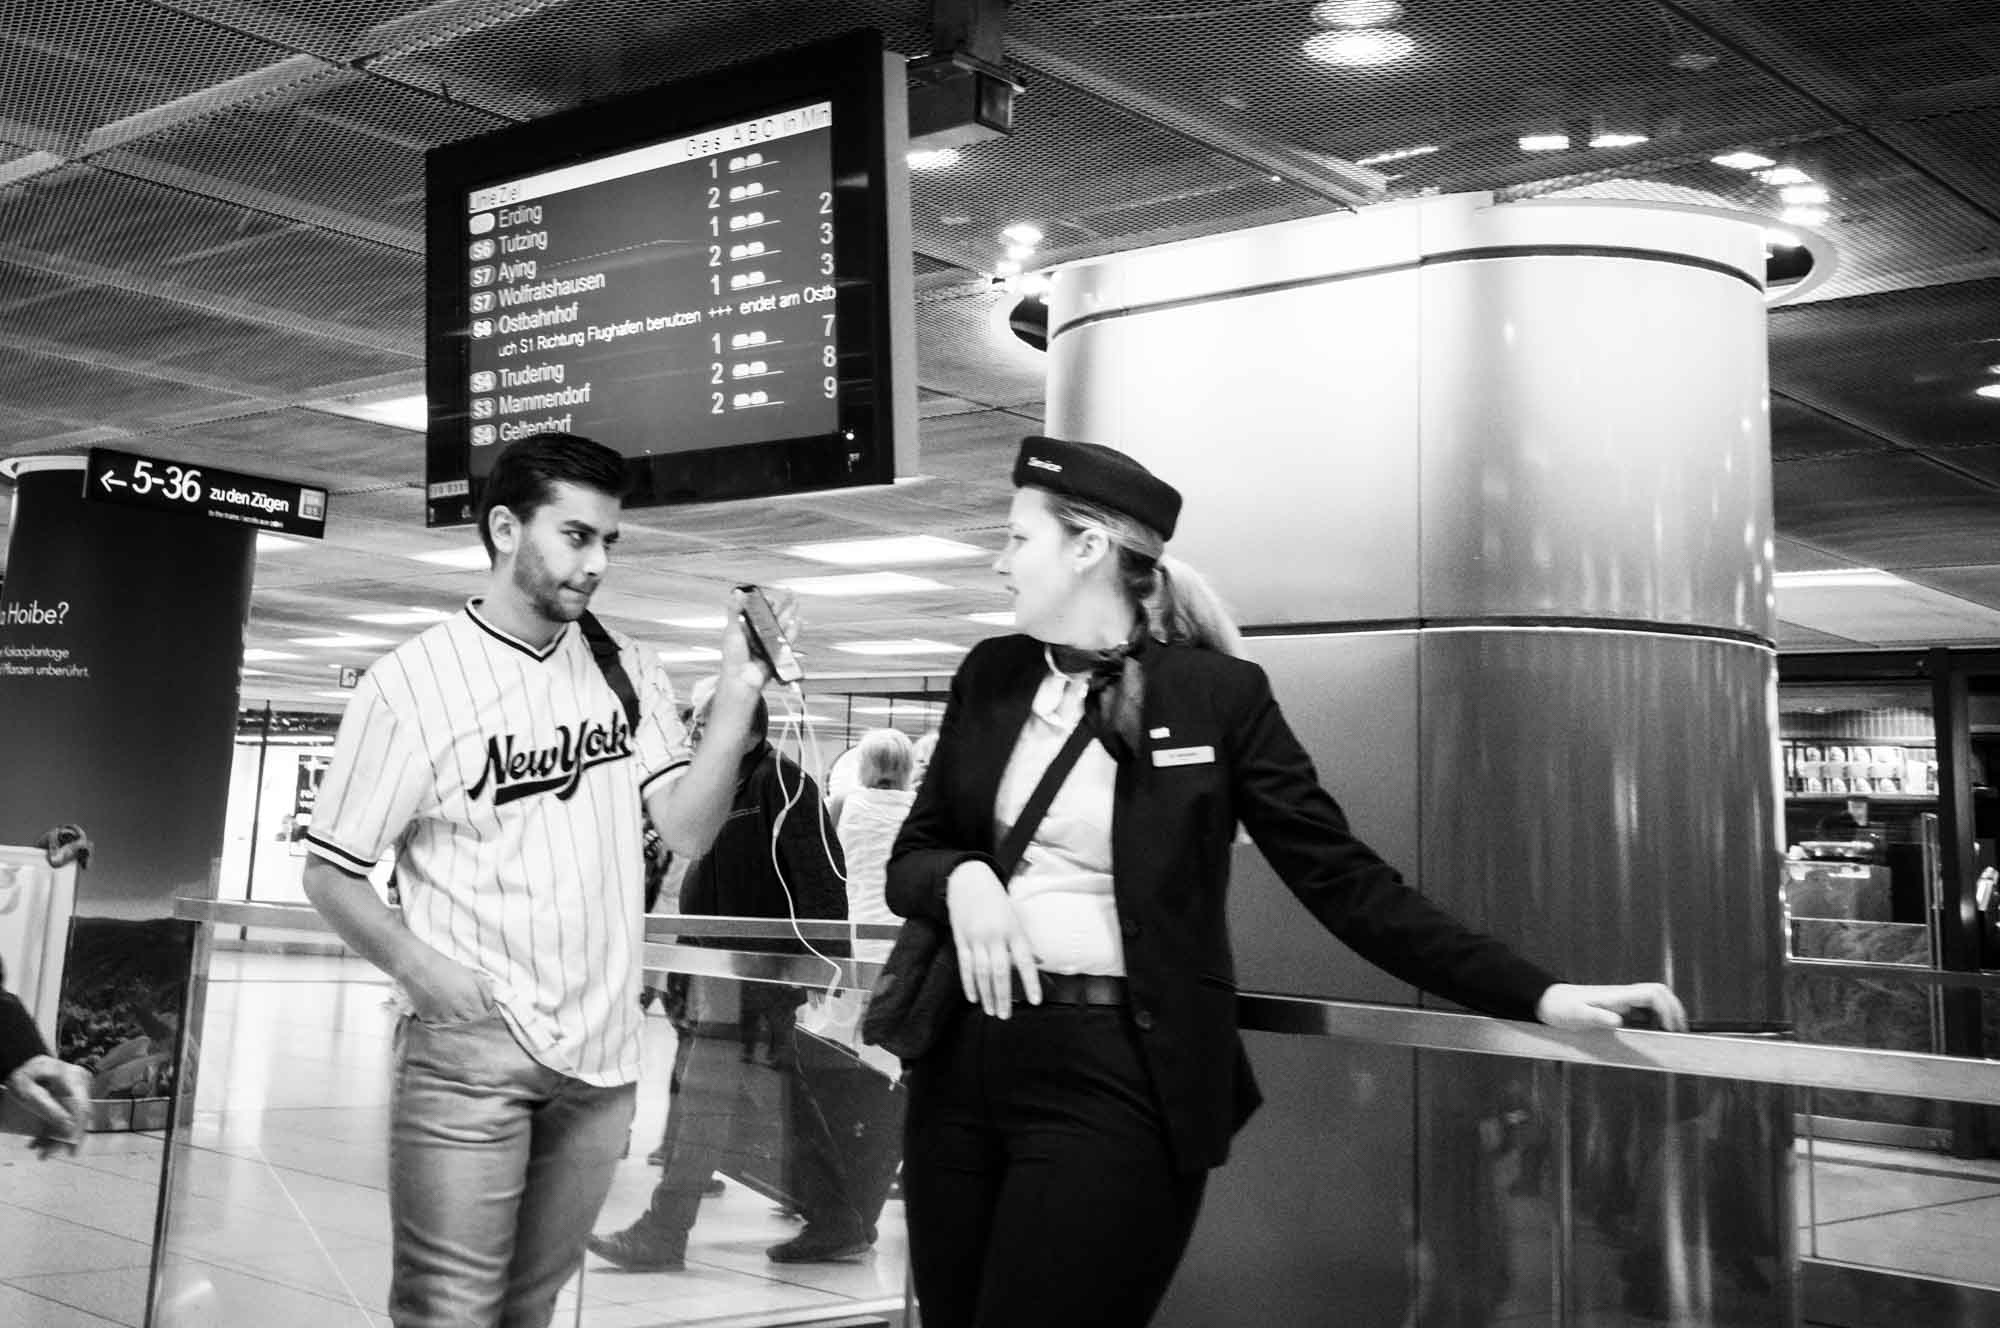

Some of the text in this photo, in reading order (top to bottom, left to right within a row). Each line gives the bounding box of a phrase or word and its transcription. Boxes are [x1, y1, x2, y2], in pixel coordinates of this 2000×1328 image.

[498, 205, 543, 228] Erding
[709, 158, 718, 179] 1
[498, 230, 548, 254] Tutzing
[708, 187, 720, 208] 2
[472, 192, 832, 286] S7 Aying 1 2
[472, 222, 834, 312] S7 Wolfratshausen 2 3
[498, 301, 579, 335] Ostbahnhof
[710, 274, 720, 296] 1
[820, 252, 835, 275] 3
[520, 337, 534, 354] S1
[537, 331, 585, 350] Richtung
[587, 319, 644, 342] Flughafen
[646, 310, 701, 331] benutzen
[739, 294, 777, 315] endet
[779, 293, 800, 308] am
[498, 361, 565, 388] Trudering
[711, 332, 721, 354] 1
[821, 314, 835, 336] 7
[498, 382, 591, 415] Mammendorf
[711, 362, 724, 384] 2
[823, 345, 837, 367] 8
[711, 392, 725, 414] 2
[824, 376, 837, 399] 9
[131, 459, 202, 503] 5-36
[209, 487, 226, 502] zu
[226, 487, 250, 506] den
[250, 491, 289, 513] Zügen
[7, 599, 70, 625] Hoibe?
[467, 710, 633, 801] New York
